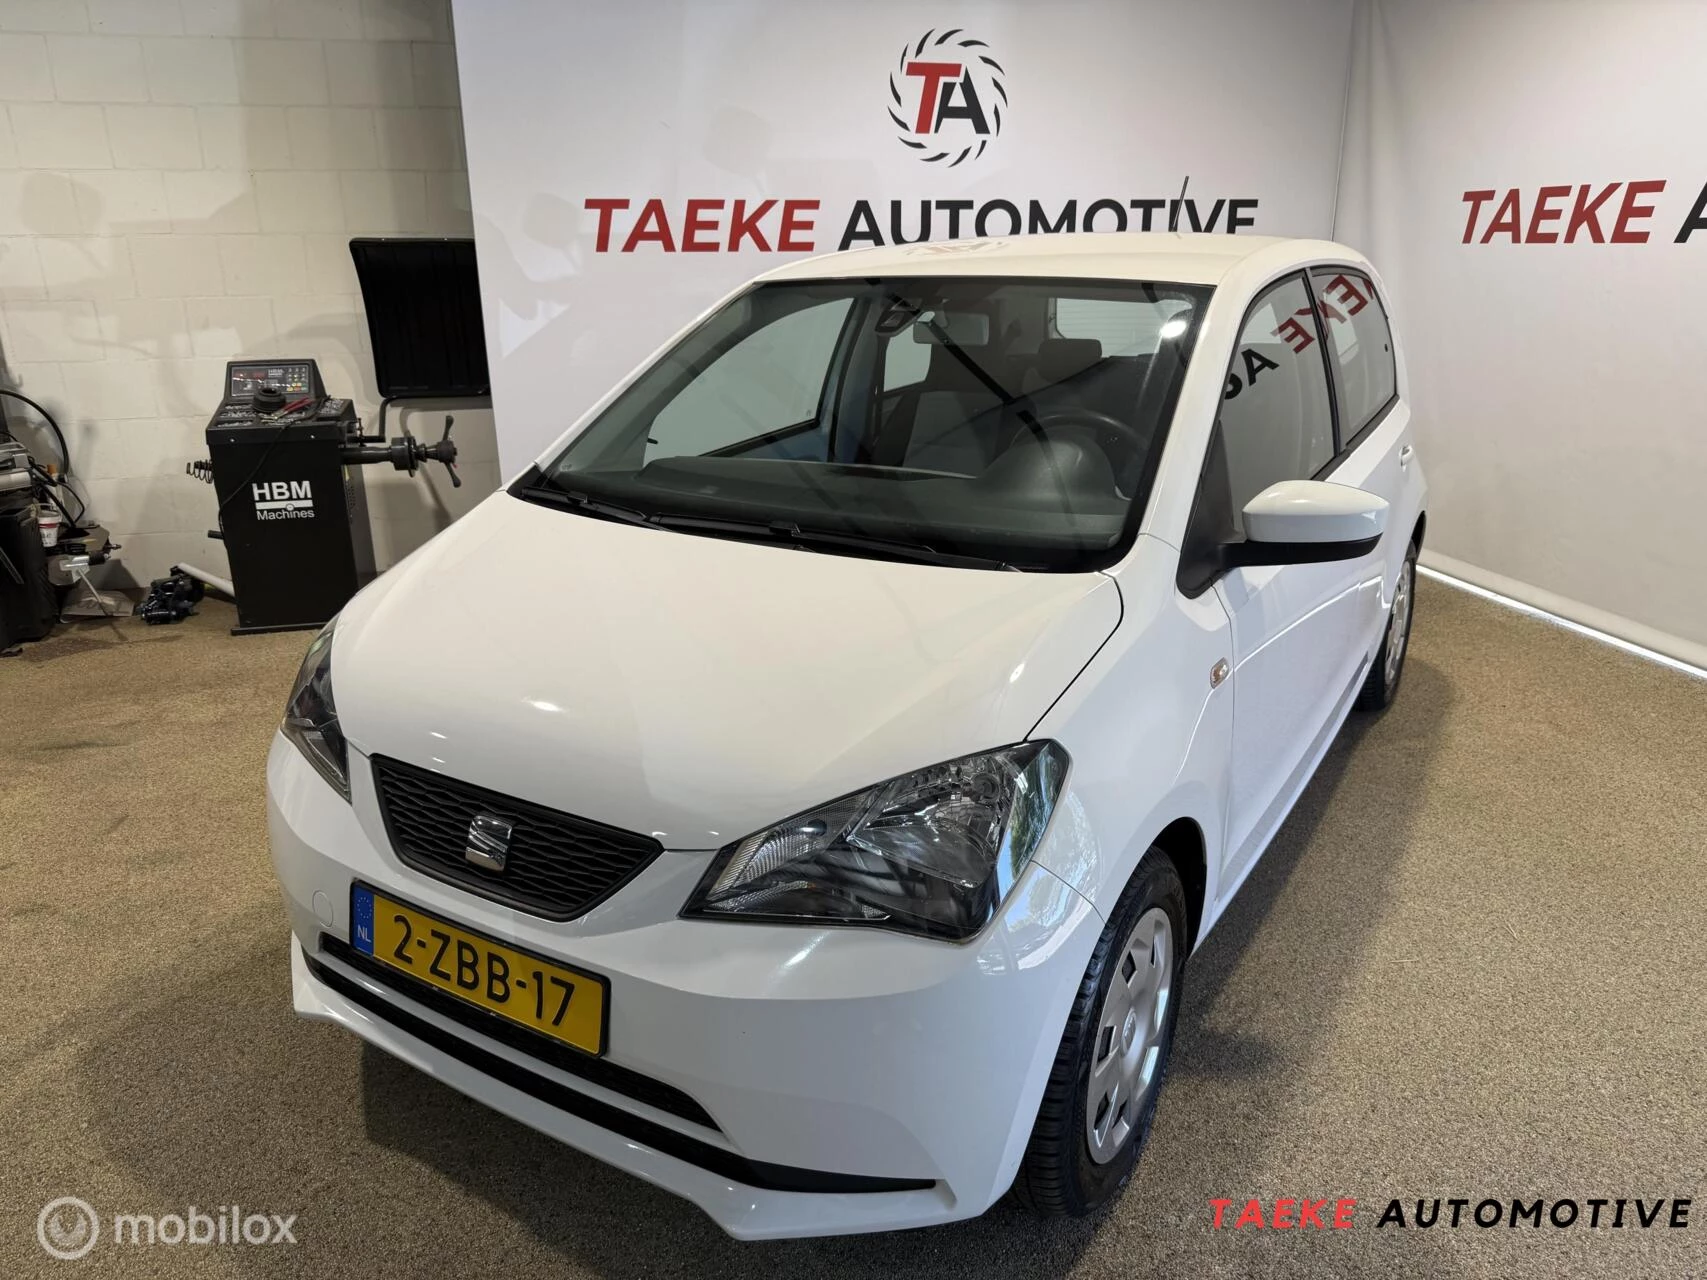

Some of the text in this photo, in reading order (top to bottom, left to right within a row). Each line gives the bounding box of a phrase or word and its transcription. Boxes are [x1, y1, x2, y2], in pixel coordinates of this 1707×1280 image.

[904, 61, 990, 134] TA
[584, 199, 820, 252] TAEKE
[1462, 180, 1667, 244] TAEKE
[252, 480, 312, 500] HBM
[256, 509, 315, 520] Machines
[357, 925, 371, 943] NL
[394, 915, 575, 1026] 2-ZBB-17
